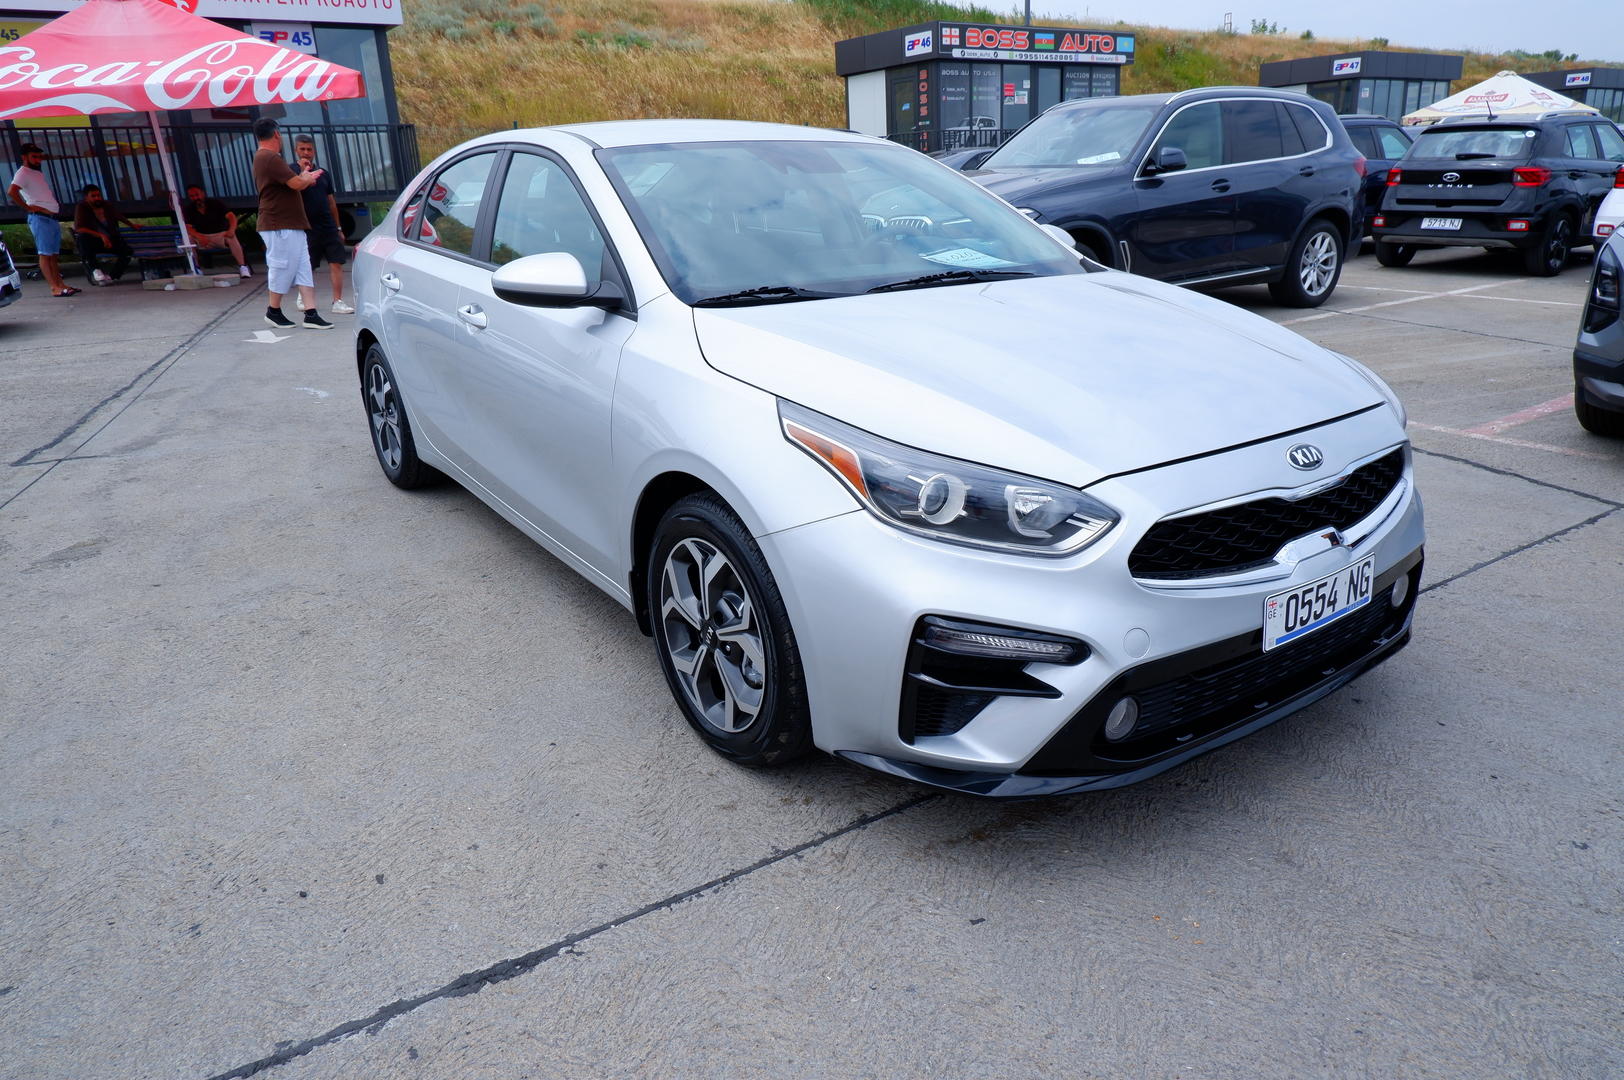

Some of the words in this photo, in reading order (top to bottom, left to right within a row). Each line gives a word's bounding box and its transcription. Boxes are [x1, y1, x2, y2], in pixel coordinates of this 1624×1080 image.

[291, 31, 313, 46] 45
[920, 36, 931, 48] 46
[965, 27, 1030, 50] BOSS
[1058, 32, 1115, 54] AUTO
[0, 37, 338, 109] oca-Cola
[1349, 61, 1360, 70] 47
[1291, 445, 1323, 466] KIA
[1285, 576, 1338, 633] 0554
[1346, 560, 1371, 606] NG
[1267, 608, 1278, 620] GE
